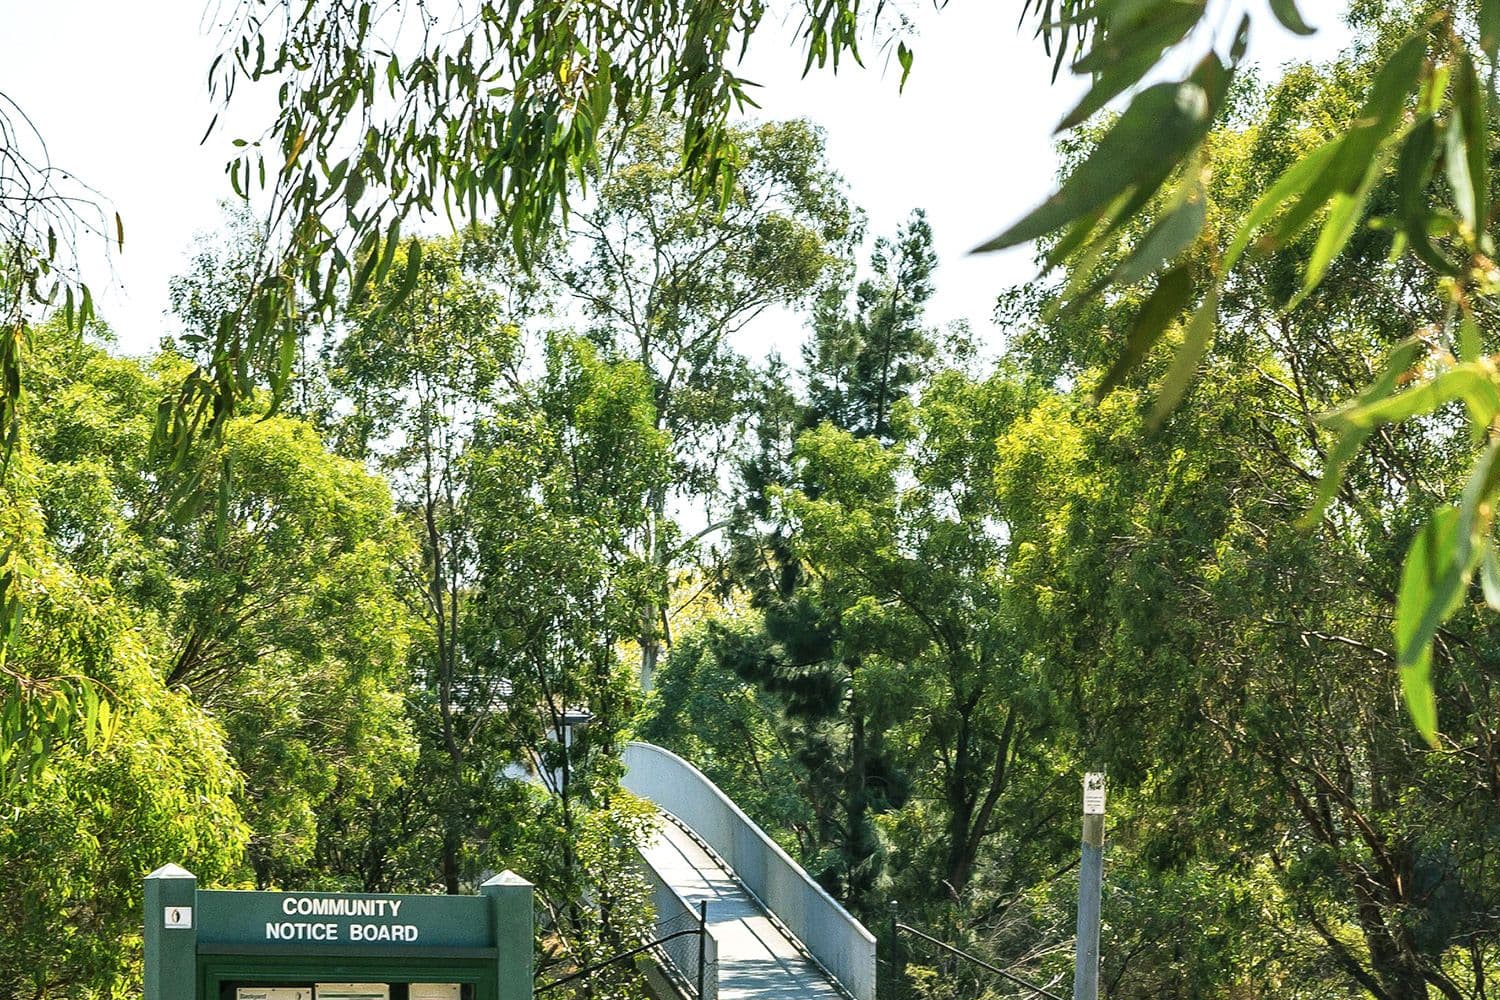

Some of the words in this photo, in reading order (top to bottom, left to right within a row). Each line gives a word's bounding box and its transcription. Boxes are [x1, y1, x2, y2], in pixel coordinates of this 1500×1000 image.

[282, 897, 402, 917] COMMUNITY
[265, 922, 338, 941] NOTICE
[350, 923, 419, 942] BOARD
